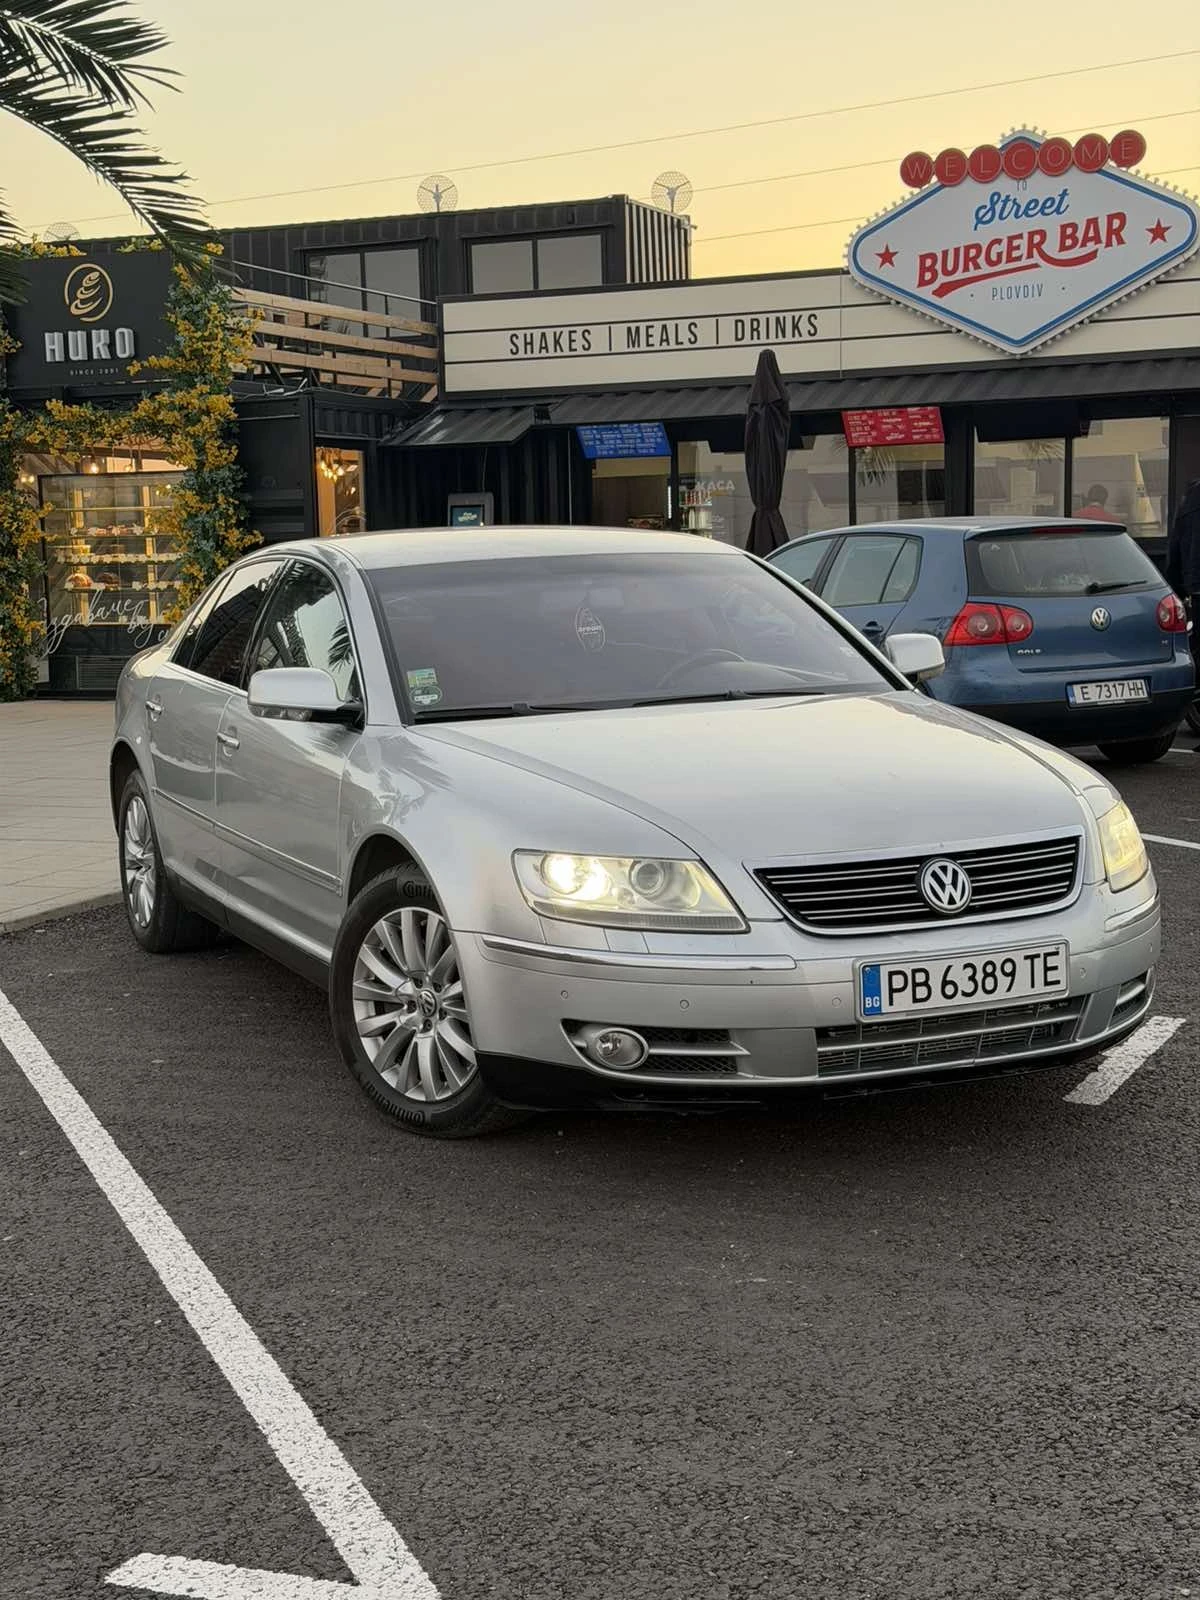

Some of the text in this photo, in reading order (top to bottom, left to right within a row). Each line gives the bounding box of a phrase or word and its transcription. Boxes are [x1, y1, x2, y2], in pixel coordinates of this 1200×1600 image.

[906, 138, 1134, 180] WELCOME
[1016, 180, 1027, 191] TO
[974, 188, 1070, 231] Street
[916, 211, 1127, 288] BURGER BAR
[991, 284, 1044, 301] PLOVDIV
[509, 313, 818, 355] SHAKES MEALS DRINKS
[69, 368, 94, 377] SINCE
[1080, 686, 1091, 701] E
[1095, 682, 1125, 700] 7317
[1127, 681, 1146, 697] HH
[887, 950, 1061, 1007] PB 6389 TE
[865, 996, 880, 1008] BG
